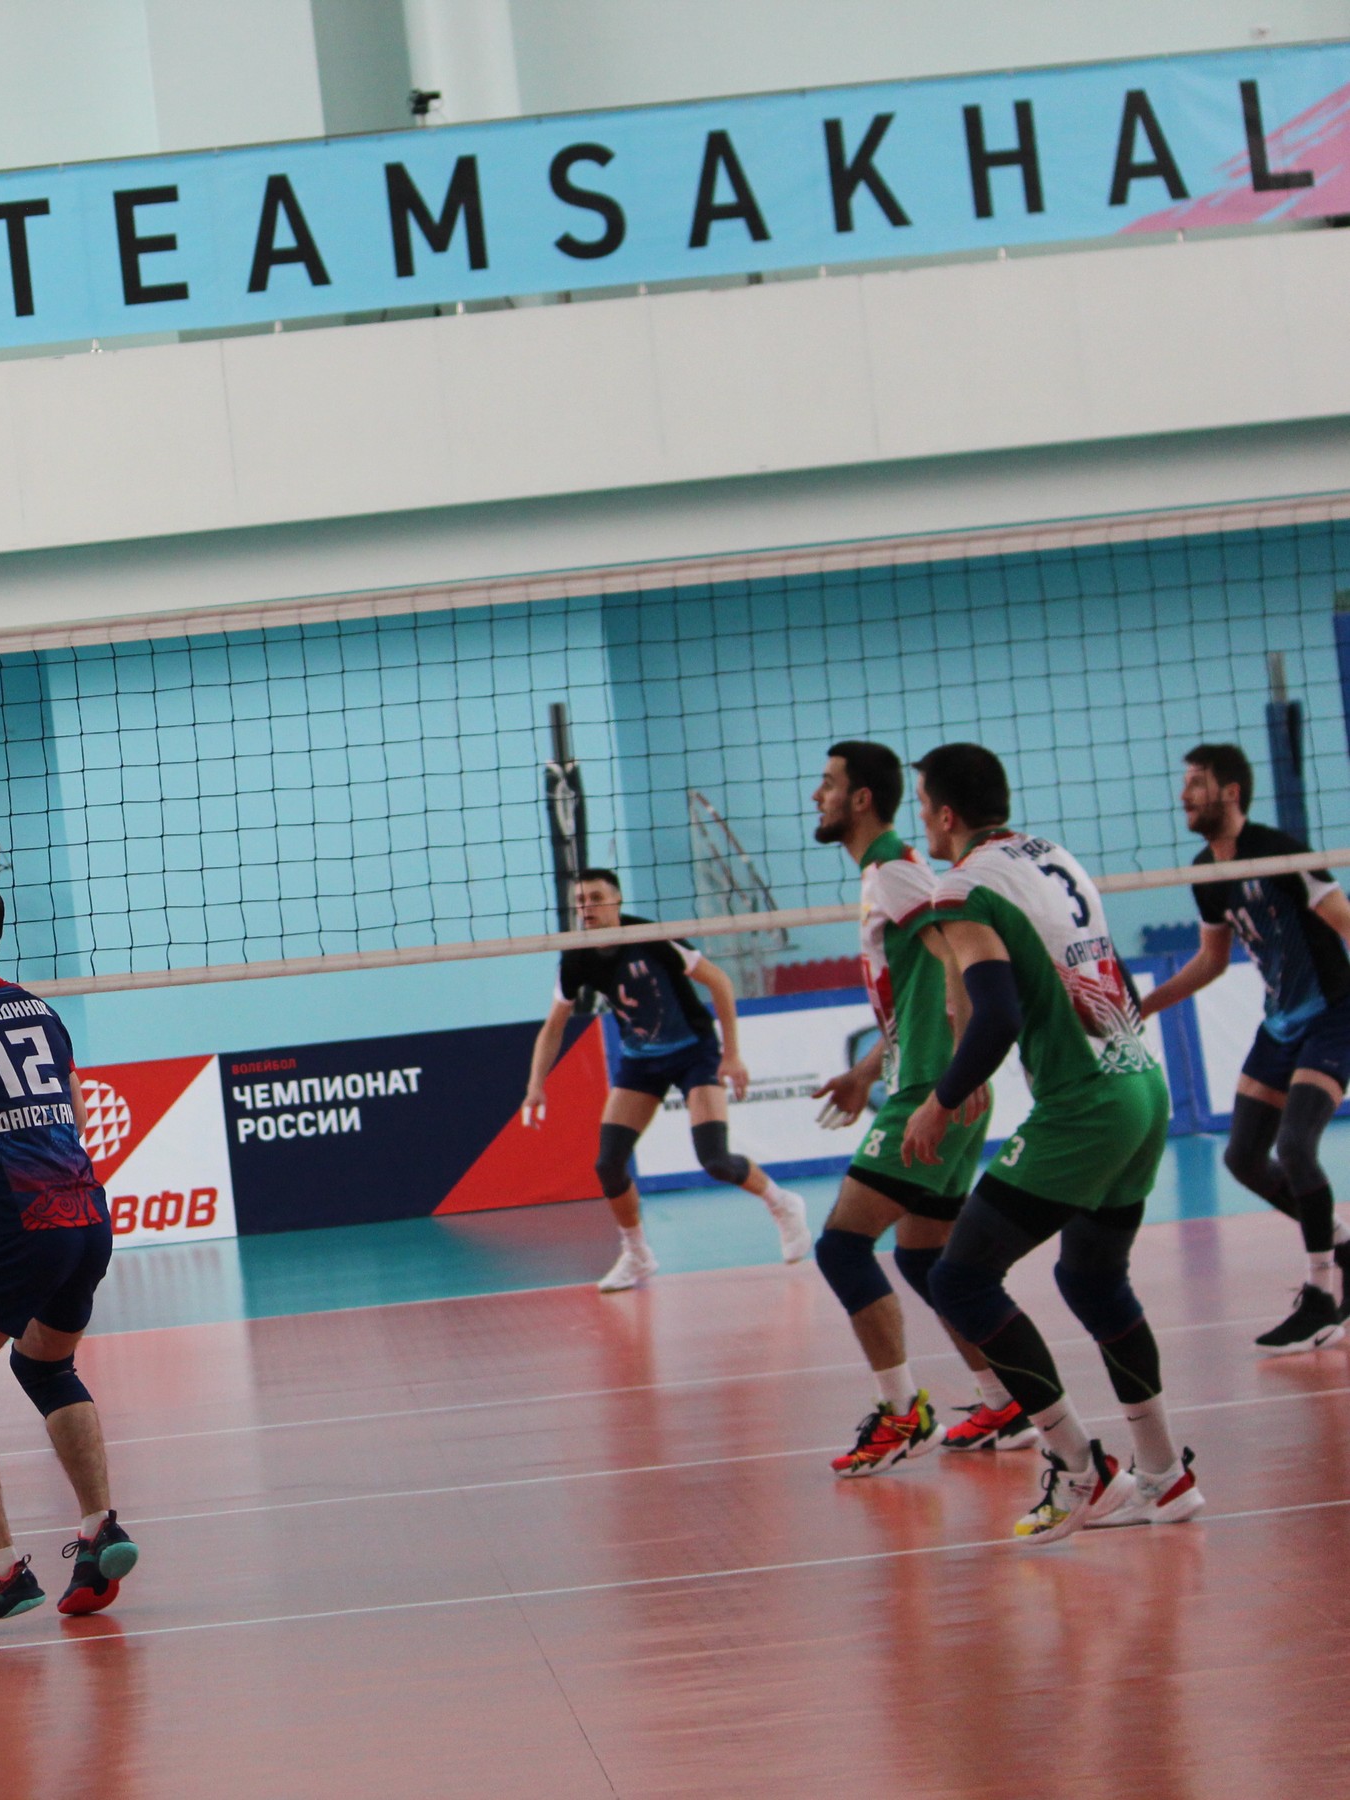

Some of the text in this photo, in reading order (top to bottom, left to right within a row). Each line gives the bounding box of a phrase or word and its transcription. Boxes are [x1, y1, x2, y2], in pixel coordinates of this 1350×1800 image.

[1037, 863, 1091, 928] 3
[231, 1057, 297, 1075] ВОЛЕЙБОЛ
[232, 1067, 423, 1111] ЧЕМПИОНАТ
[236, 1106, 362, 1144] РОССИИ
[863, 1129, 887, 1158] 8
[1000, 1135, 1026, 1167] 3
[111, 1186, 218, 1235] ВФВ
